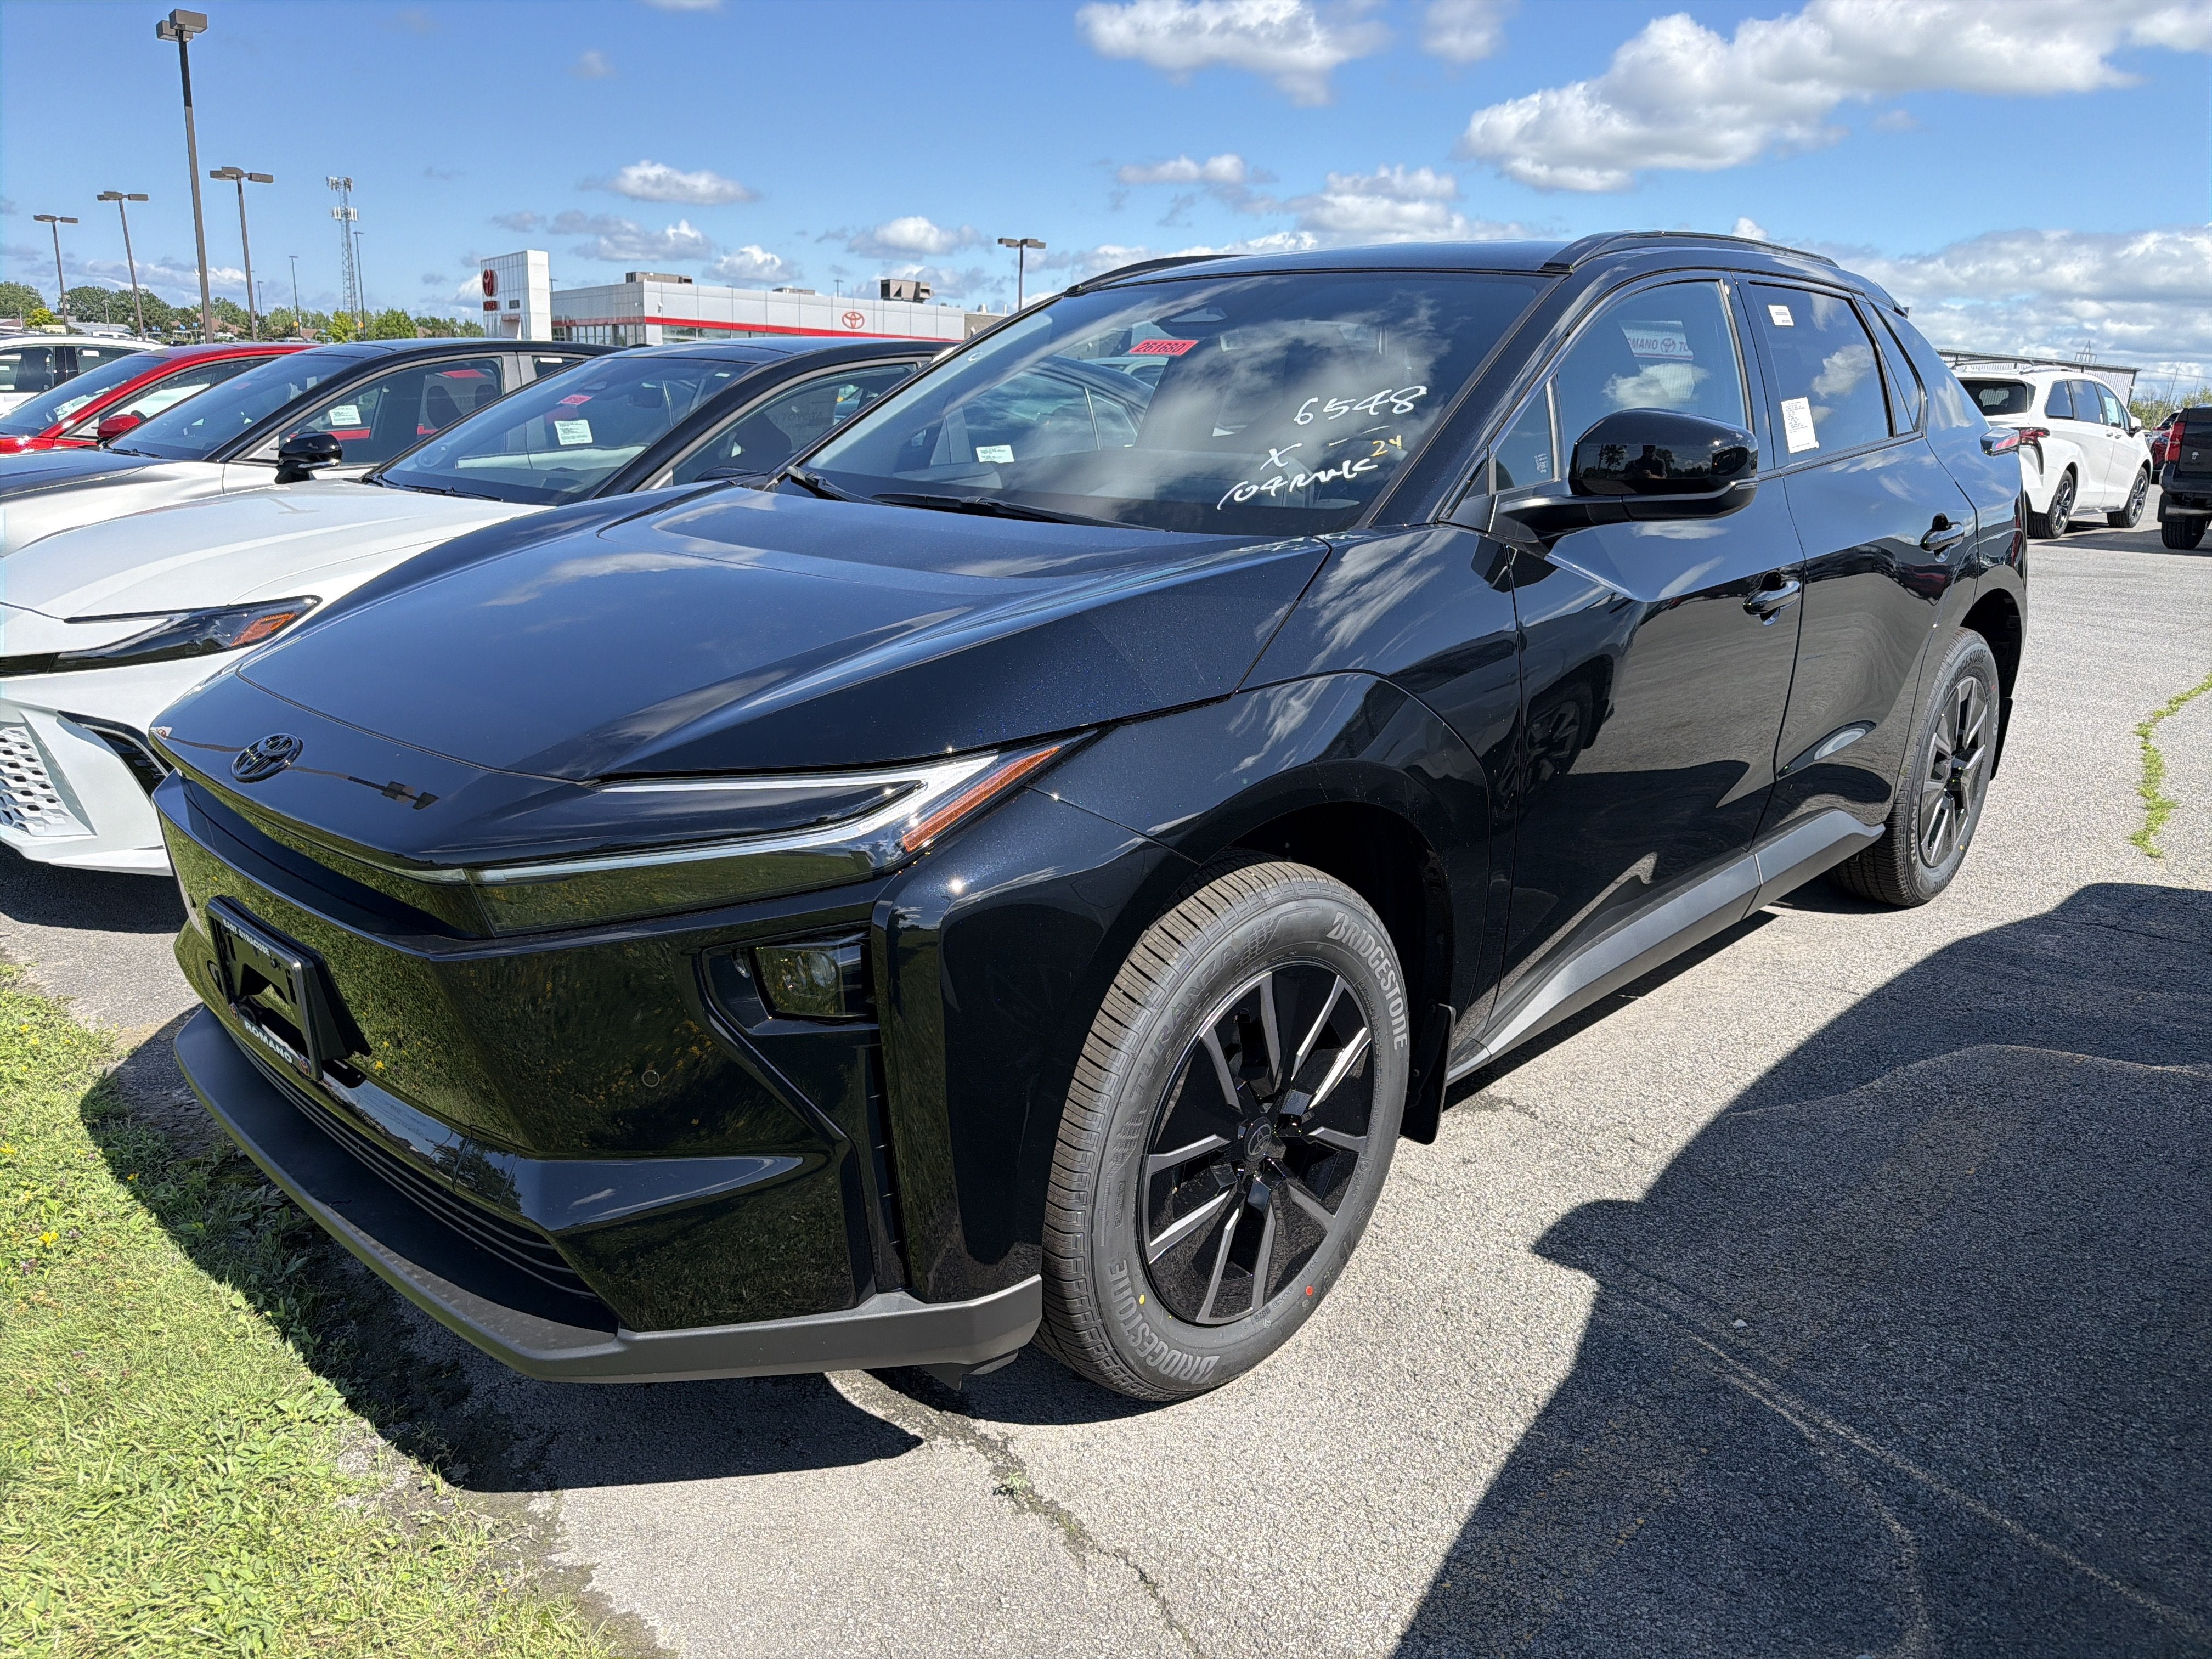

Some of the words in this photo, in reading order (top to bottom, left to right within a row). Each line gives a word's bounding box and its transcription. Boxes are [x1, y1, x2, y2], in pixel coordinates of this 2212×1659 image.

[1135, 342, 1186, 353] 261680
[1943, 648, 1987, 701] BRIDGESTONE
[223, 918, 238, 934] EAST
[239, 929, 270, 957] SYRACUSE
[1325, 911, 1409, 1051] BRIDGESTONE
[244, 1020, 293, 1063] ROMANO
[1129, 946, 1237, 1099] TURANZA
[1109, 1256, 1220, 1385] BRIDGESTONE
